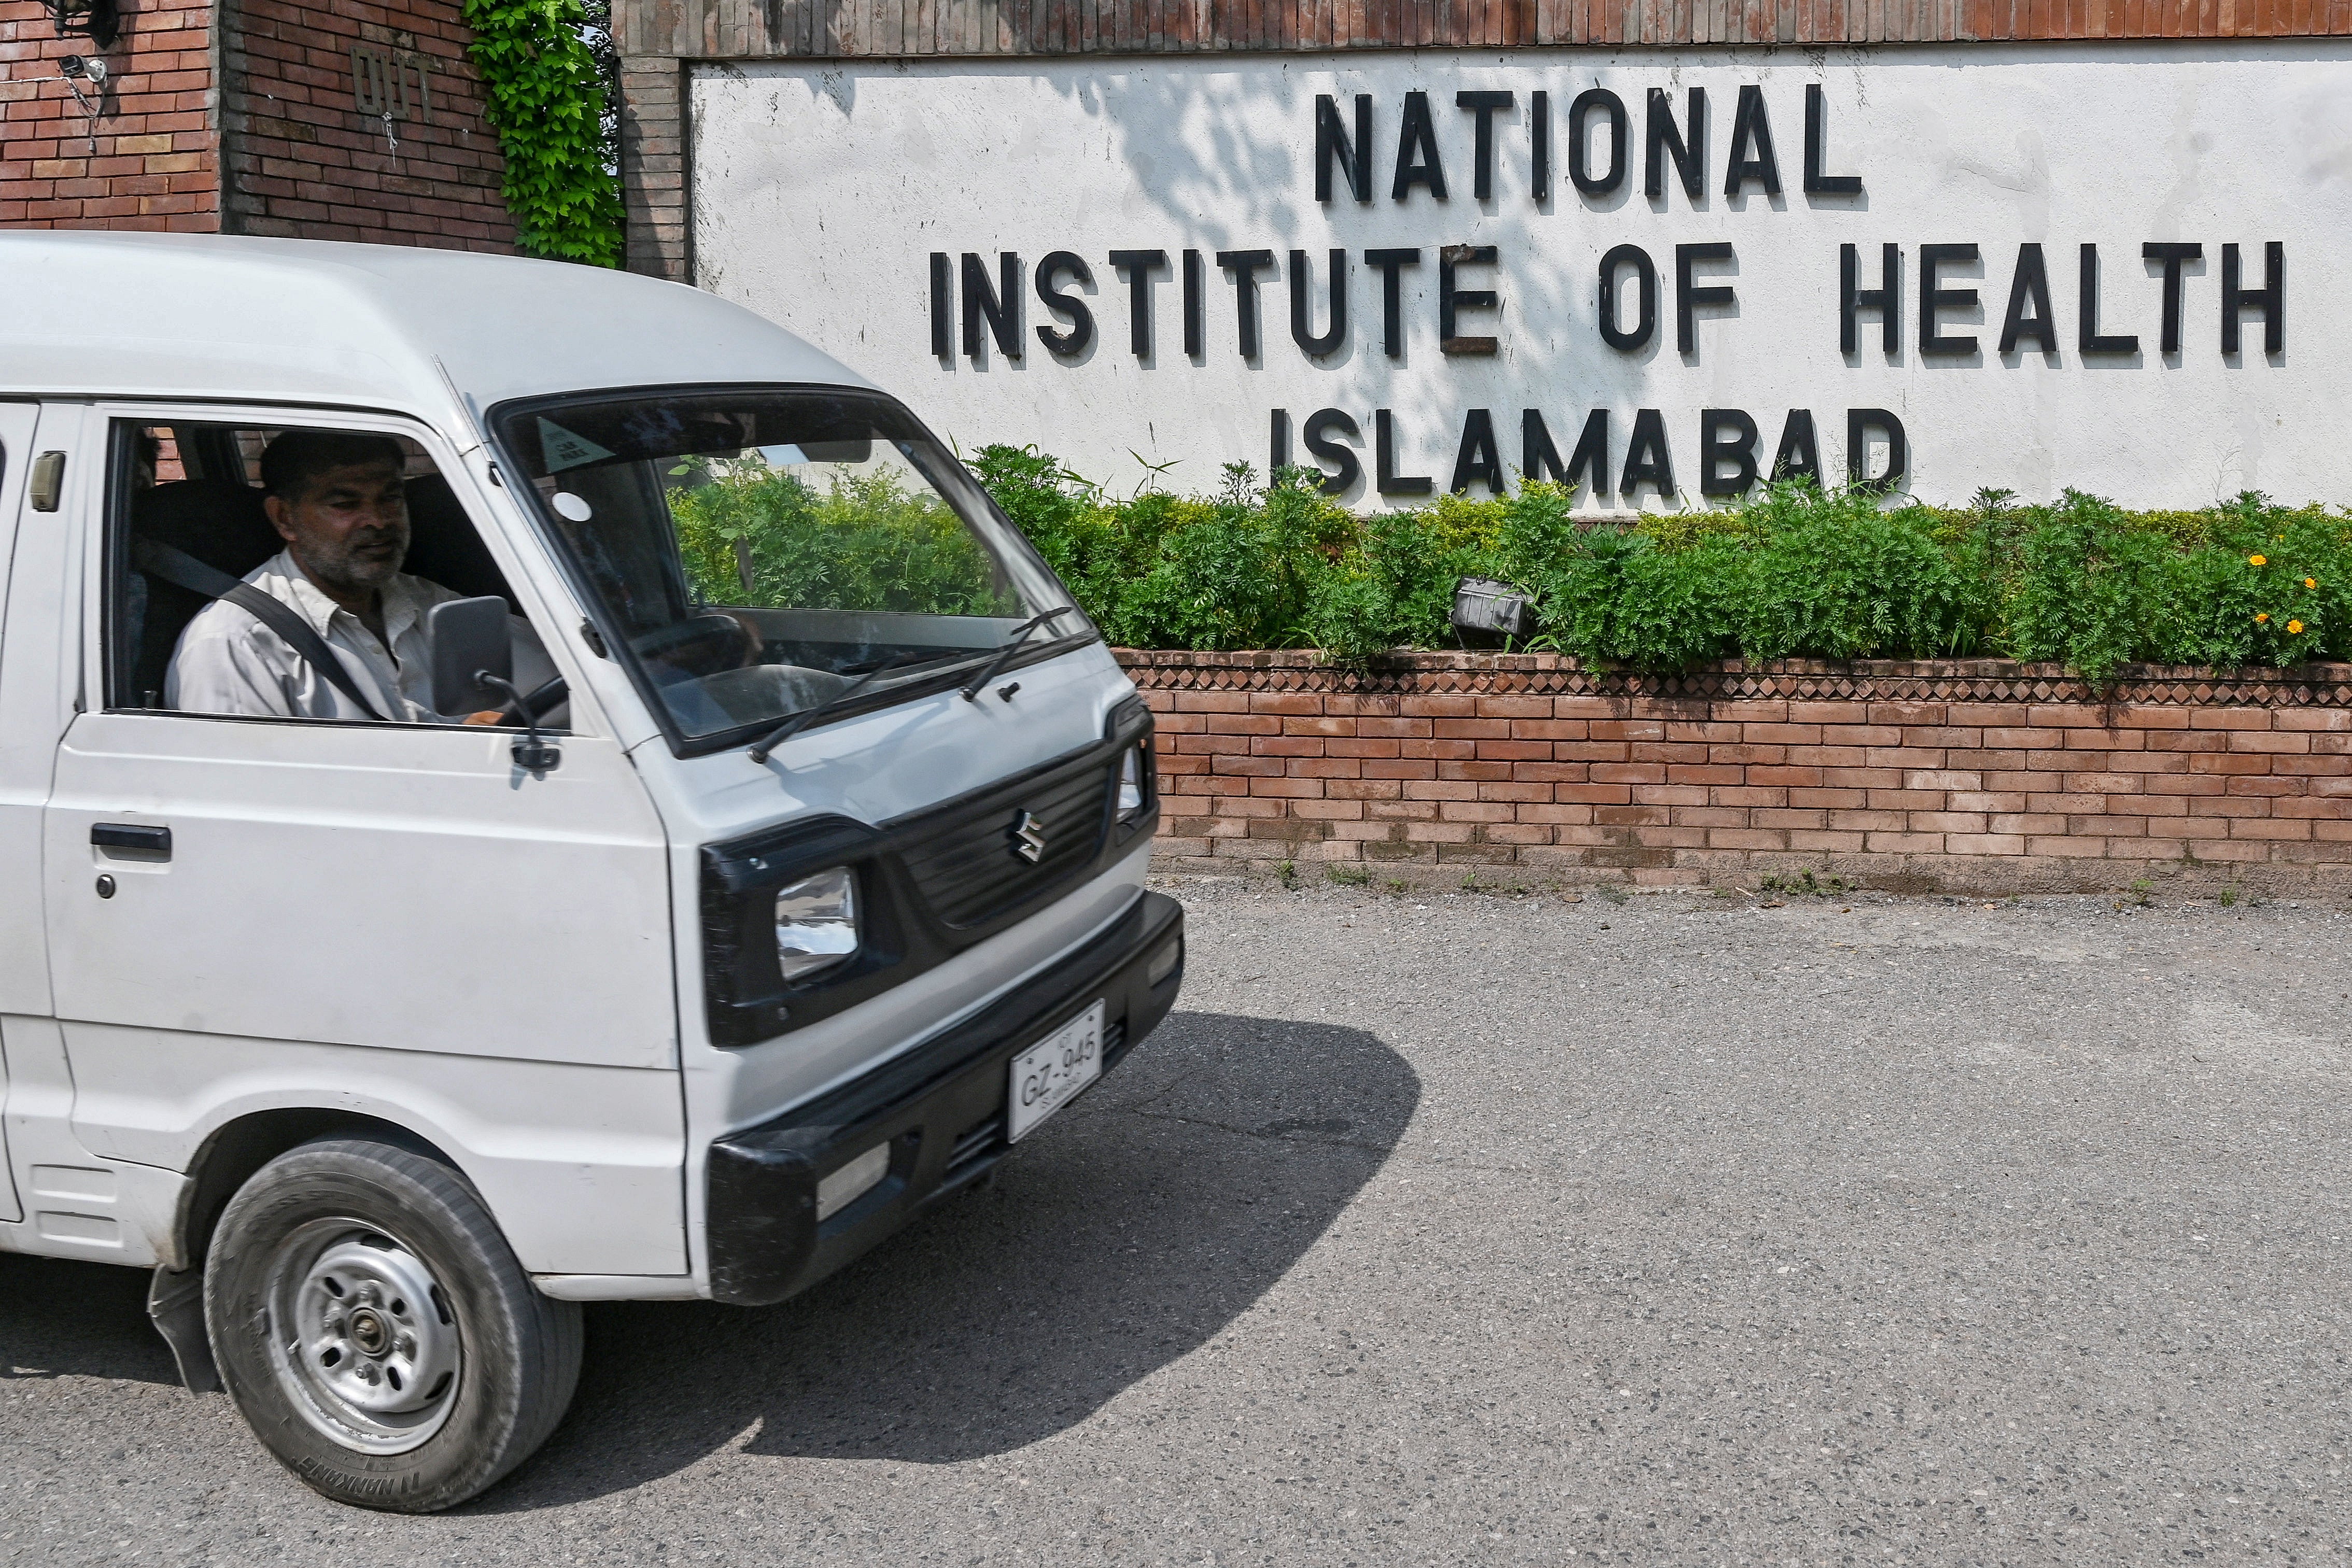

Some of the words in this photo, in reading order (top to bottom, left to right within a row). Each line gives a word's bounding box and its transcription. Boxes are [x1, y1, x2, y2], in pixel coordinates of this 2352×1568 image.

[349, 46, 436, 124] OUT
[1314, 83, 1863, 204] NATIONAL
[929, 245, 1500, 360] INSTITUTE
[1597, 242, 1738, 356] OF
[1840, 241, 2284, 357] HEALTH
[1270, 408, 1906, 496] ISLAMABAD
[1021, 1030, 1095, 1107] GZ-945
[298, 1456, 395, 1495] NANKANG
